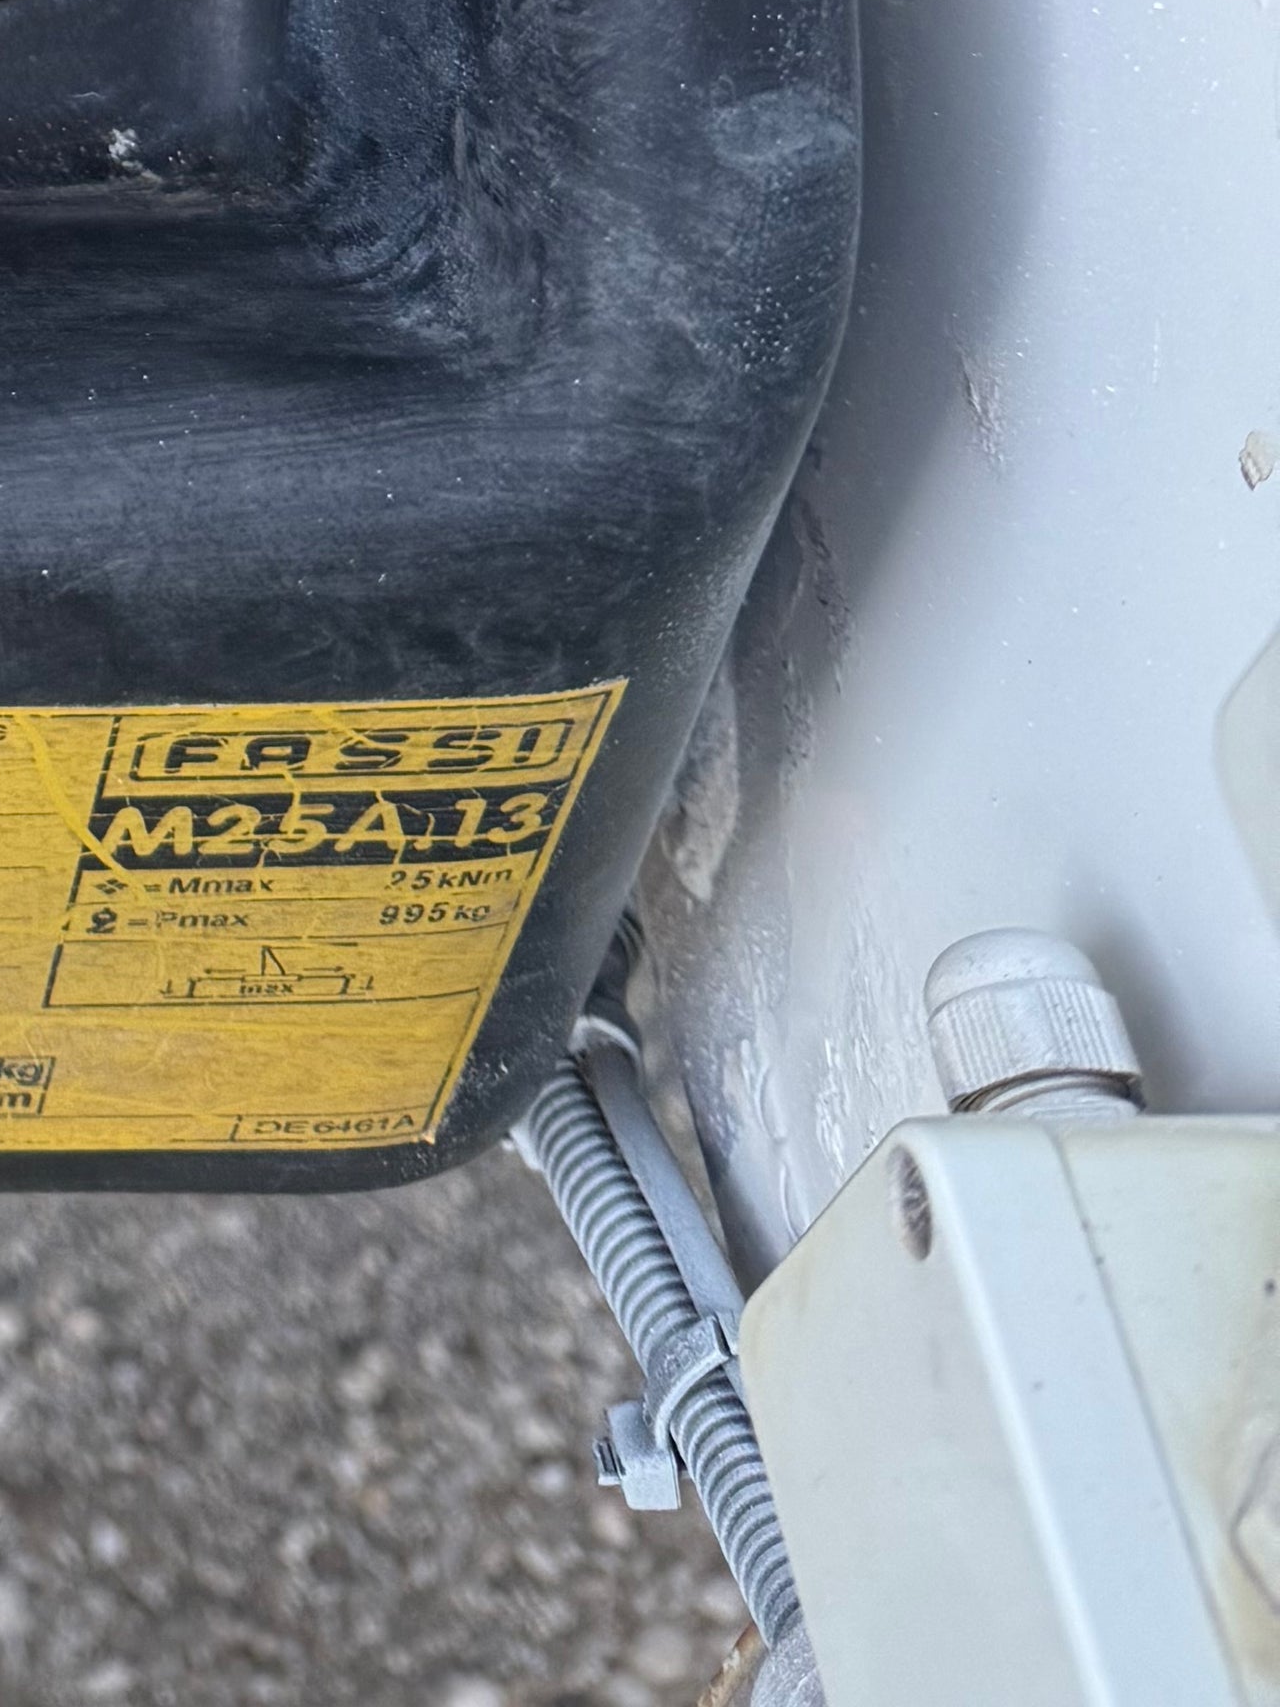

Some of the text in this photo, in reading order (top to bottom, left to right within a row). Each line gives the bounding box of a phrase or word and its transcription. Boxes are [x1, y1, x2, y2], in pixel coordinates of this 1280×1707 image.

[163, 728, 543, 775] FASSI
[104, 792, 550, 857] M25A.13
[169, 876, 275, 896] Mmax
